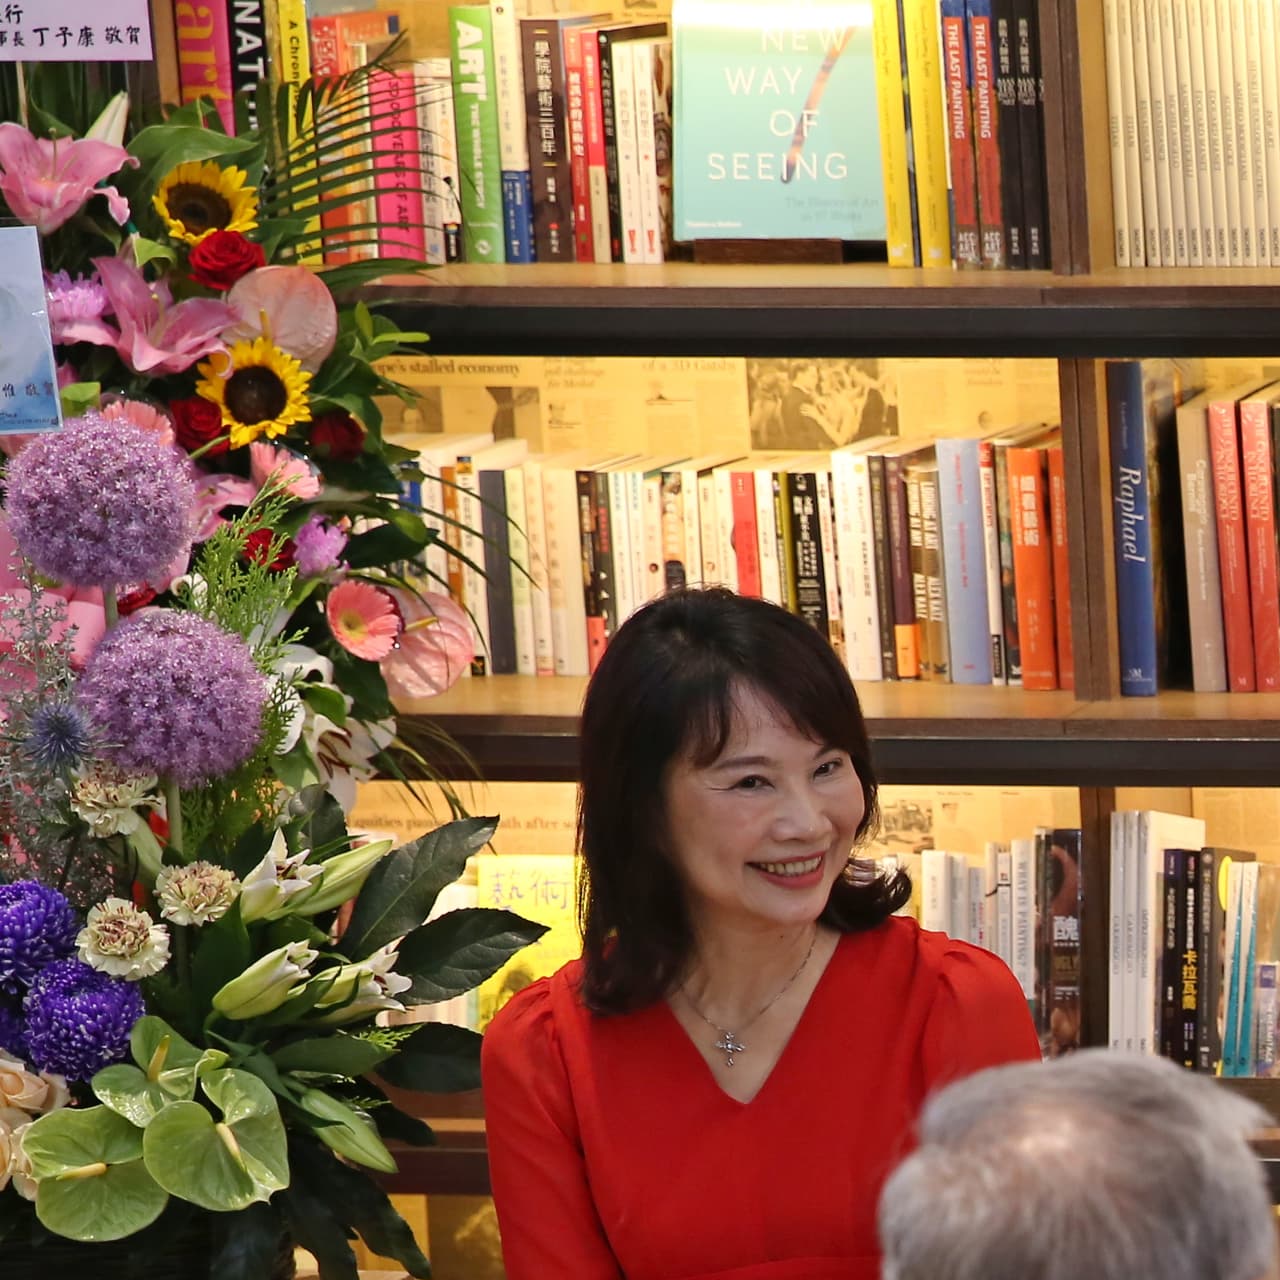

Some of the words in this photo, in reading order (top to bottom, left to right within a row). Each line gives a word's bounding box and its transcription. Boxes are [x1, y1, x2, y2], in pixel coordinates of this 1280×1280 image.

[0, 4, 23, 24] 行
[761, 29, 844, 52] NEW
[947, 24, 958, 47] THE
[974, 23, 985, 47] THE
[456, 20, 487, 101] ART
[949, 49, 960, 79] LAST
[975, 48, 987, 78] LAST
[724, 66, 802, 95] WAY
[534, 40, 556, 156] 學院藝術三百年
[951, 81, 964, 140] PAINTING
[977, 80, 991, 140] PAINTING
[769, 109, 818, 137] OF
[707, 153, 849, 181] SEEING
[1195, 458, 1209, 526] Caravaggio
[1116, 465, 1147, 564] Raphael
[925, 533, 940, 550] ART
[928, 576, 943, 599] ALEX
[929, 600, 945, 622] KATZ
[1018, 861, 1028, 890] WHAT
[1017, 911, 1029, 967] PAINTING?
[1182, 949, 1198, 1010] 卡拉瓦喬
